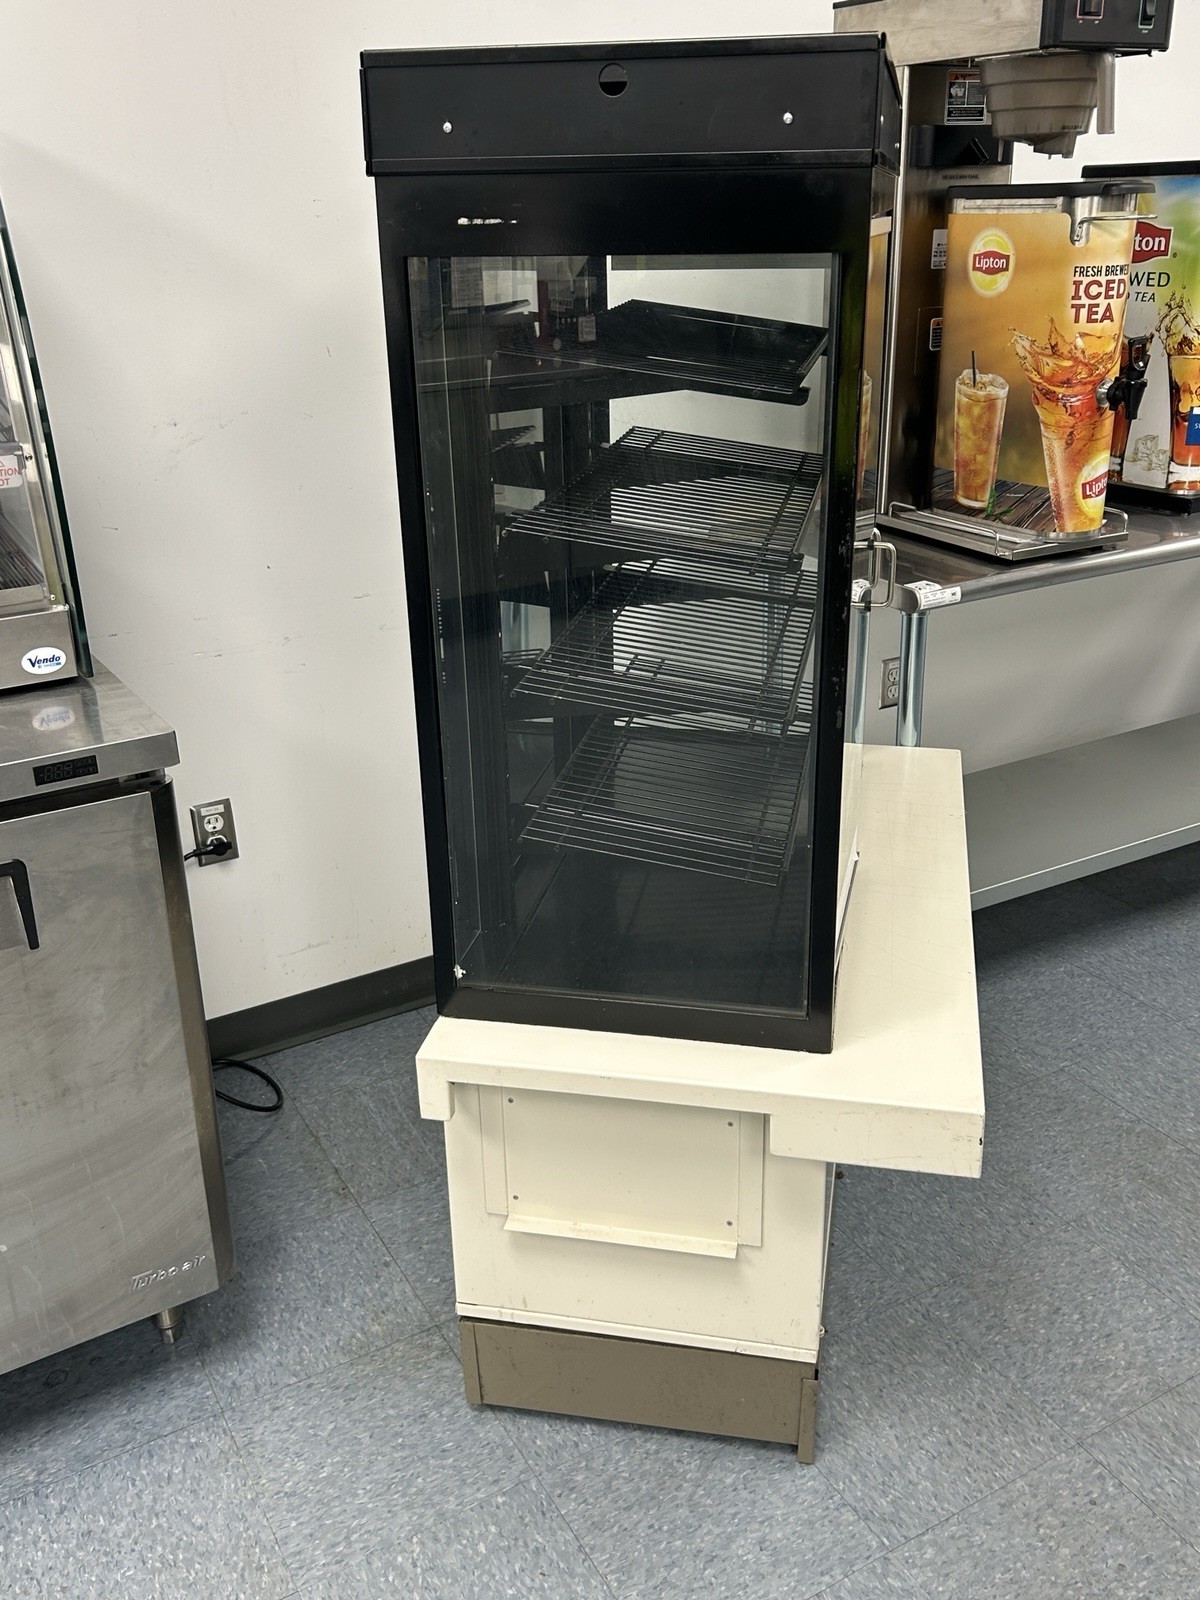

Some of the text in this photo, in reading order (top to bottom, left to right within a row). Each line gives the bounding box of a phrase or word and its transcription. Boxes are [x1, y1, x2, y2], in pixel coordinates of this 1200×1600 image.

[975, 256, 1007, 270] Lipton
[1073, 264, 1129, 277] FRESH BREWED
[1071, 279, 1127, 300] ICED
[1134, 292, 1156, 302] TEA
[1071, 302, 1115, 324] TEA
[27, 654, 61, 668] Vendo
[132, 1255, 206, 1290] Turbo air
